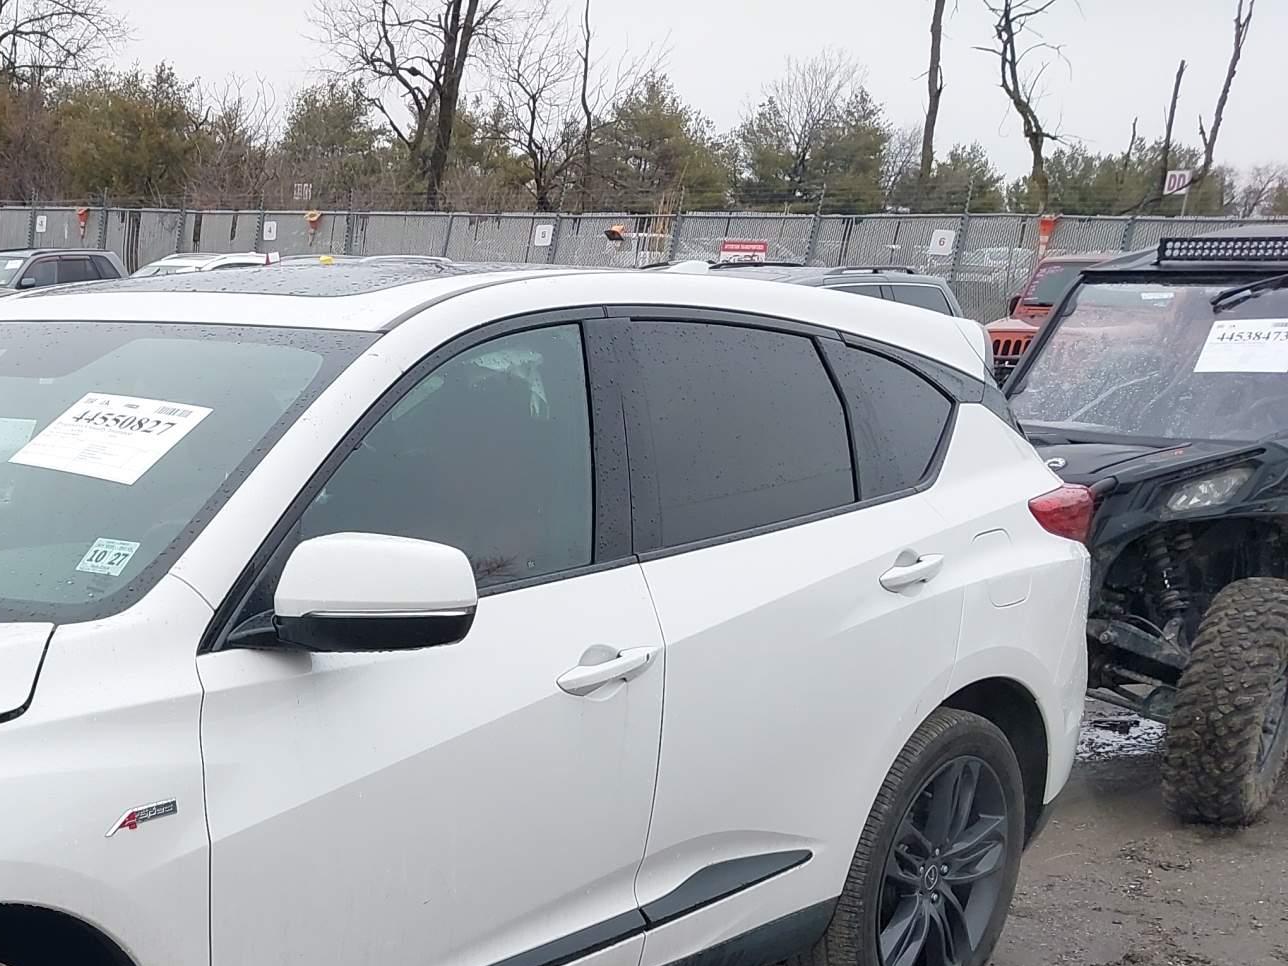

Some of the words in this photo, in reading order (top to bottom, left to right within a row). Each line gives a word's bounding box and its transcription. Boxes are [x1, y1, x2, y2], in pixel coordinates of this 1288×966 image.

[1168, 174, 1186, 191] DD
[939, 237, 945, 246] 6
[72, 410, 178, 436] 44550827
[86, 549, 108, 563] 10
[107, 552, 129, 566] 27
